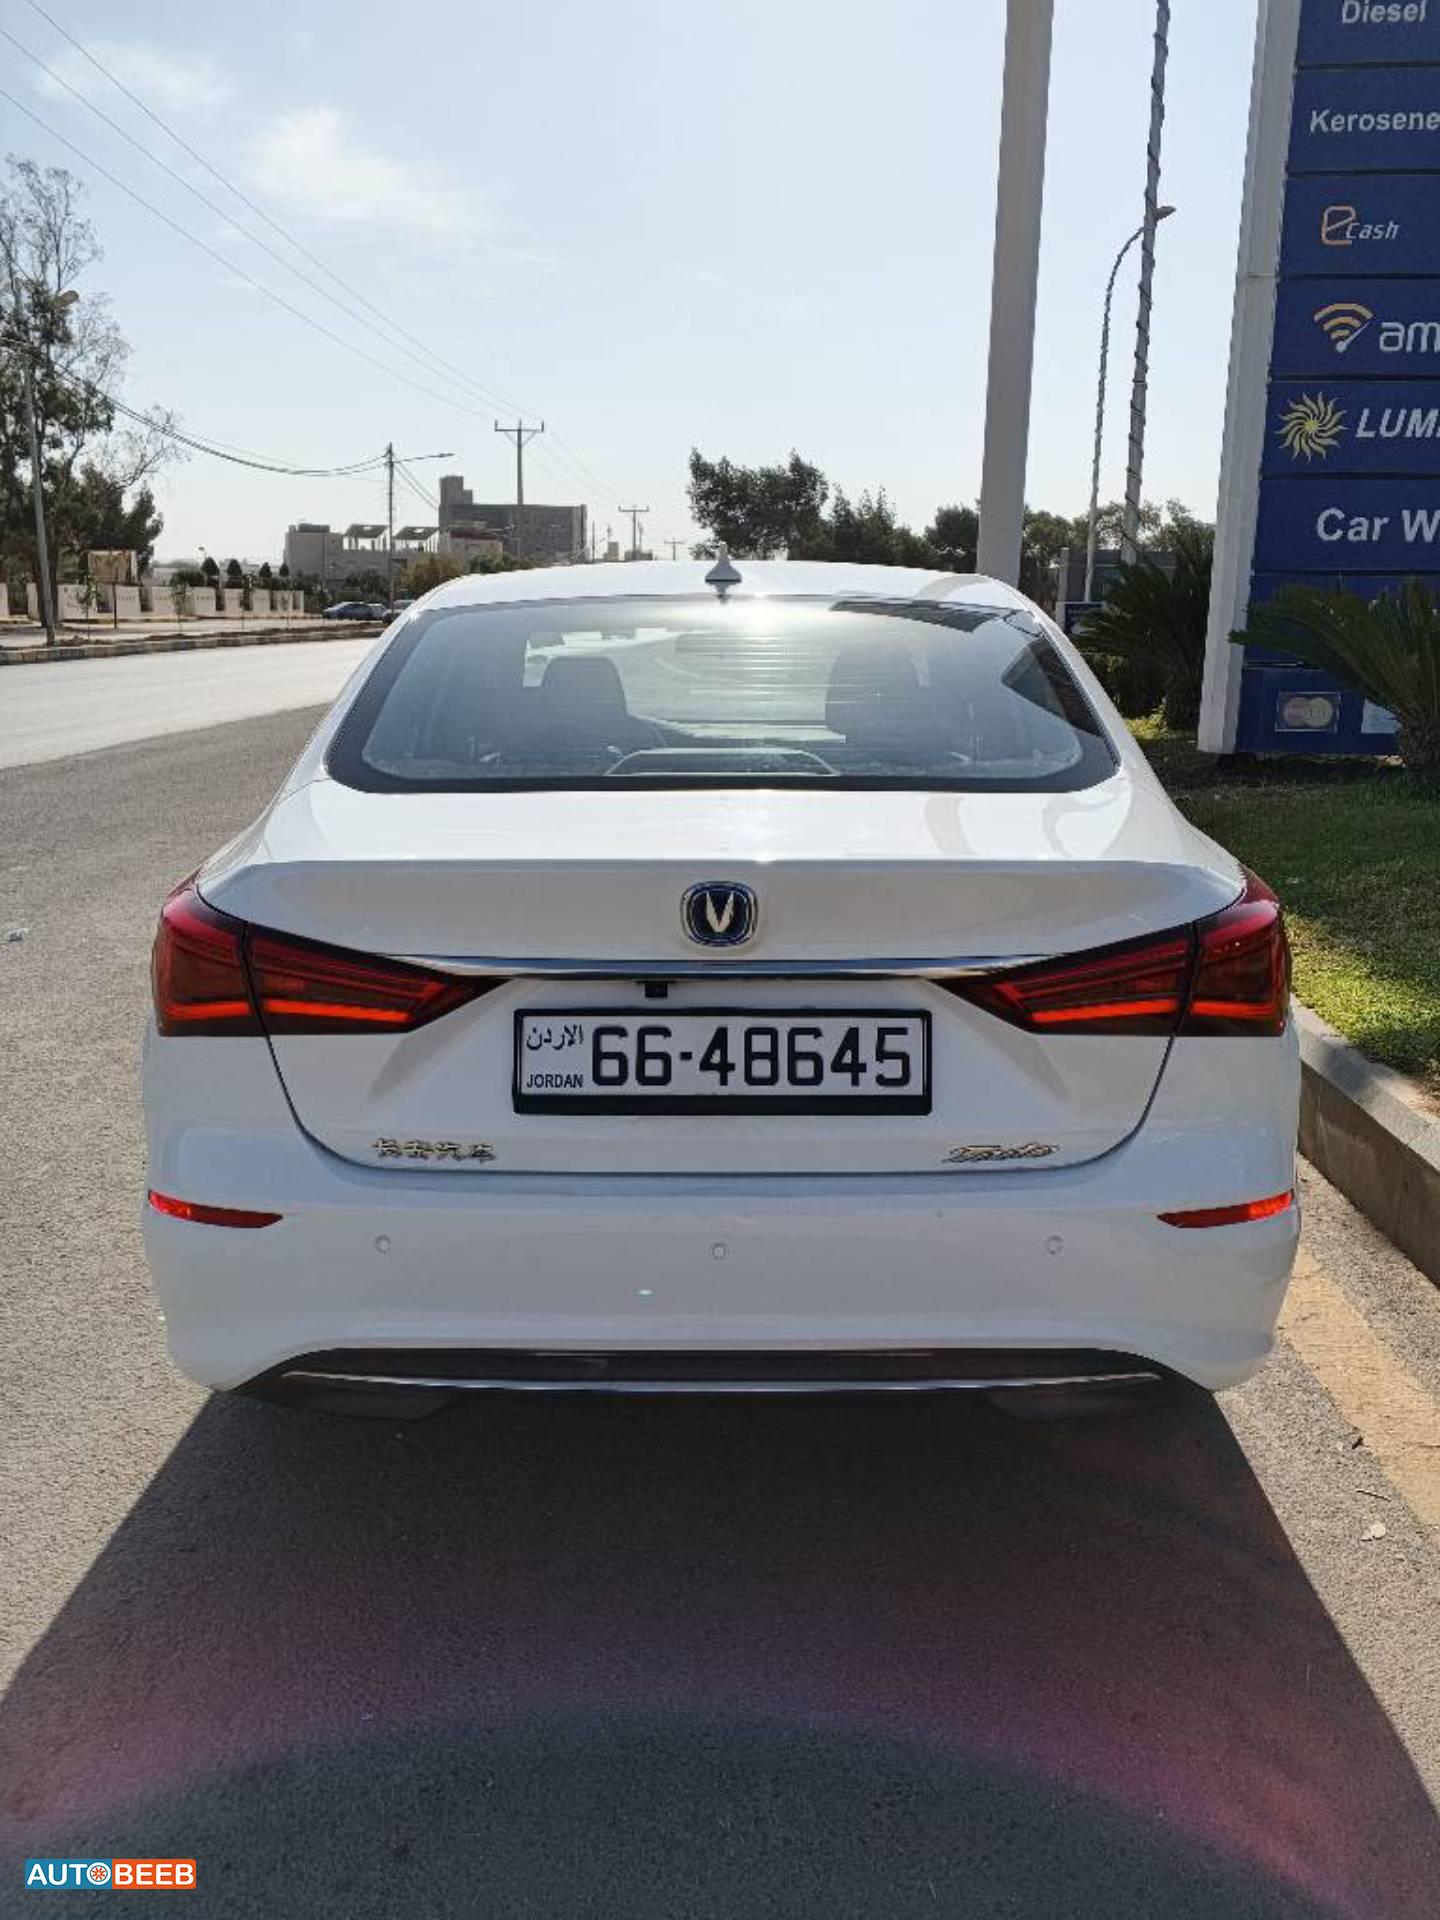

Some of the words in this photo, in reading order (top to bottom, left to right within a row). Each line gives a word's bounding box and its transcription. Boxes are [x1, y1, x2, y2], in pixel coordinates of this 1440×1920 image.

[1341, 0, 1427, 24] Diesel
[1309, 109, 1440, 133] Kerosene
[1356, 407, 1440, 438] LUM
[1316, 507, 1389, 541] Car
[592, 1026, 911, 1087] 66-48645
[526, 1074, 584, 1088] JORDAN
